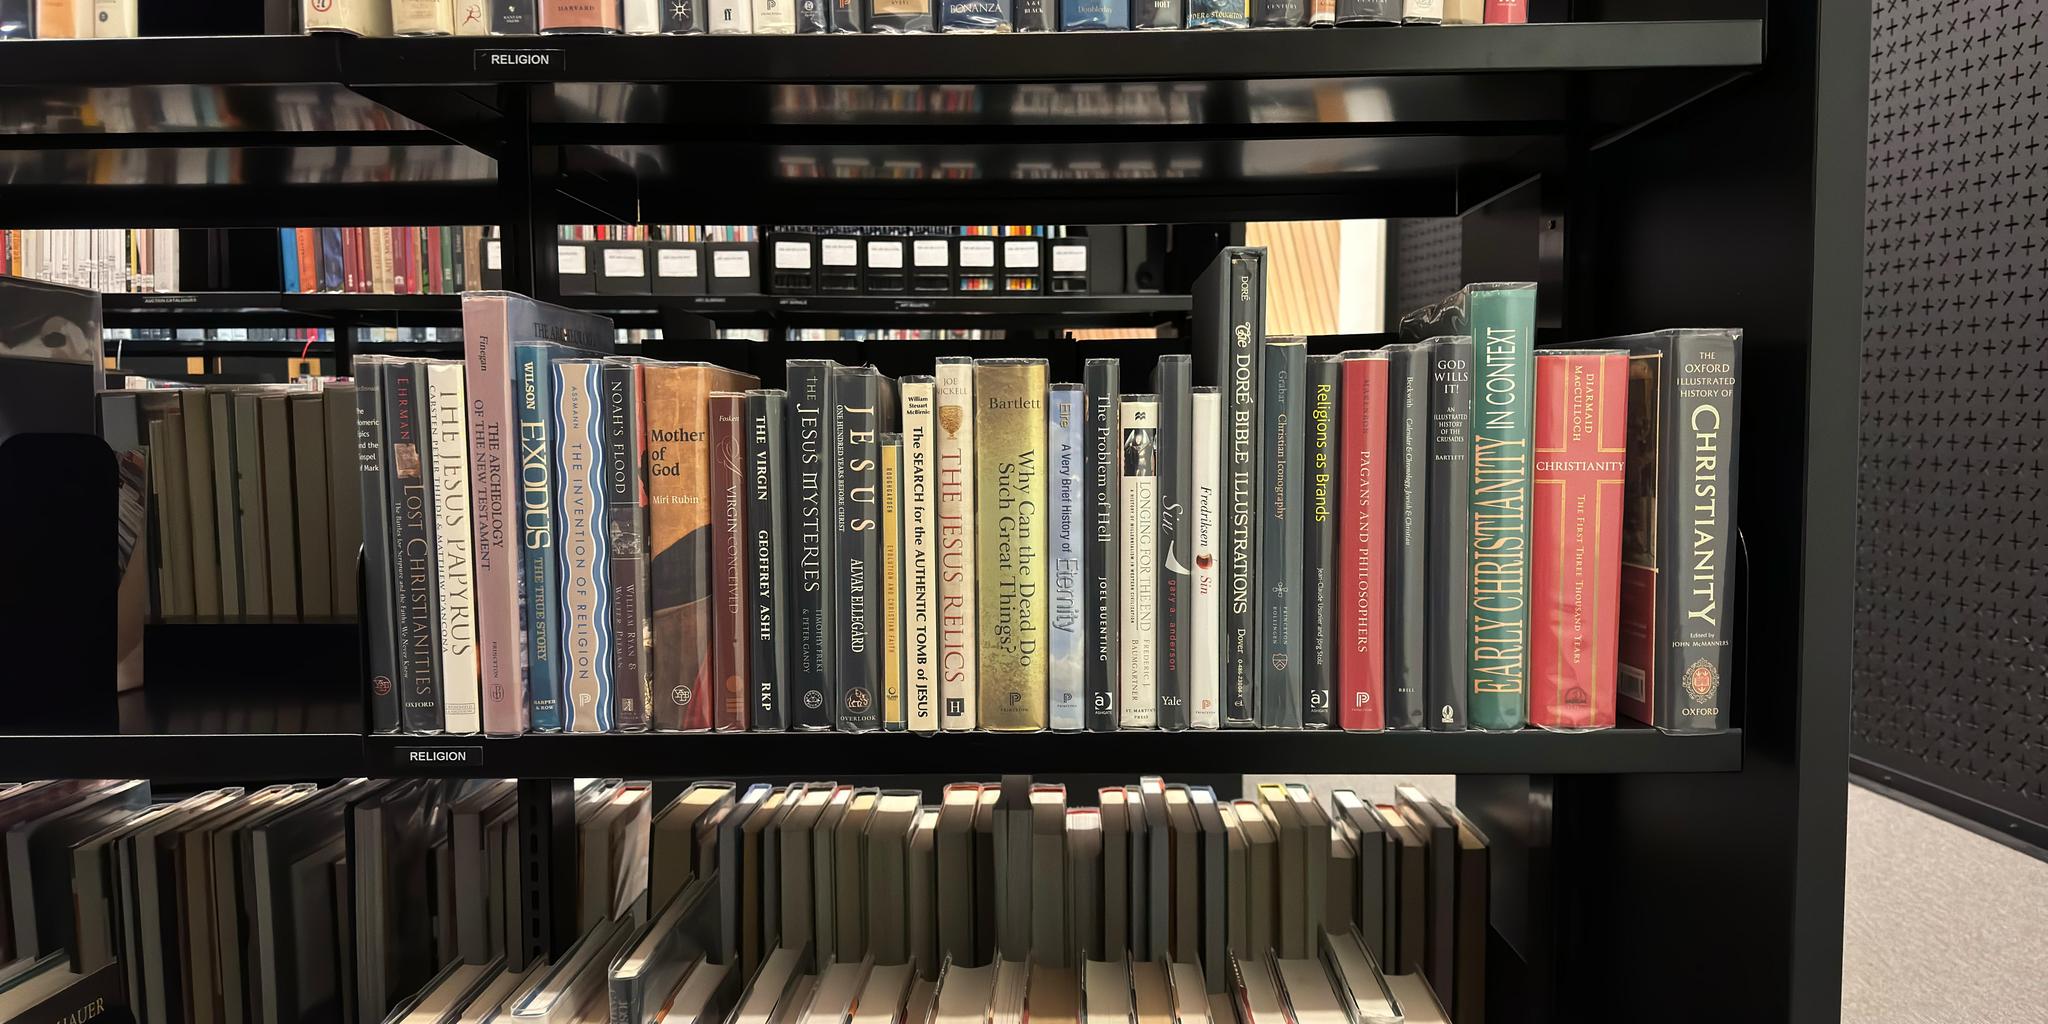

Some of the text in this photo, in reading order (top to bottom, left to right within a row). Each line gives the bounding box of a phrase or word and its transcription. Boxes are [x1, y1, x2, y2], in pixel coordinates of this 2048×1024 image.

[950, 5, 1002, 14] BONANZA
[491, 54, 549, 65] RELIGION
[1240, 275, 1251, 302] DORÉ
[479, 335, 490, 372] Finegan
[1437, 360, 1466, 370] GOD
[1685, 364, 1730, 373] OXFORD
[1699, 351, 1716, 360] THE
[524, 361, 536, 410] WILSON
[1278, 370, 1288, 404] Grabar
[1406, 376, 1414, 408] Beckwith
[1434, 372, 1469, 382] WILLS
[1444, 384, 1460, 394] IT!
[1676, 377, 1736, 386] ILLUSTRATED
[1680, 389, 1719, 398] HISTORY
[396, 378, 410, 440] EHRMAN
[571, 386, 579, 430] ASSMANN
[989, 397, 1041, 409] Bartlett
[1572, 365, 1584, 441] MacCULLOCH
[1584, 373, 1595, 434] DIARMAID
[611, 381, 626, 494] NOAH'S FLOOD
[651, 427, 705, 442] Mother
[652, 446, 667, 461] of
[796, 403, 820, 464] JESUS
[1312, 384, 1331, 522] Religions as Brands
[652, 462, 681, 476] God
[755, 416, 768, 501] THE VIRGIN
[844, 404, 876, 533] JESUS
[1060, 454, 1072, 476] Very
[1097, 393, 1111, 543] The Problem of Hell
[1232, 321, 1254, 614] The DORÉ BIBLE ILLUSTRATIONS
[1274, 413, 1288, 520] Christian Iconography
[1403, 453, 1413, 489] Chronology,
[1536, 461, 1624, 472] CHRISTIANITY
[473, 400, 491, 571] OF THE NEW TESTAMENT
[488, 422, 504, 548] THE ARCHEOLOGY
[520, 418, 551, 550] EXODUS
[652, 495, 700, 504] Miri Rubin
[1062, 479, 1072, 503] Brief
[1404, 489, 1413, 510] Jewish
[801, 472, 821, 593] MYSTERIES
[1060, 505, 1073, 540] History
[1162, 494, 1184, 535] Sin
[1199, 486, 1213, 547] Fredriksen
[1473, 326, 1526, 695] EARLY CHRISTIANITY IN CONTEXT
[1688, 403, 1720, 626] CHRISTIANITY
[572, 443, 589, 679] THE INVENTION OF RELIGION
[939, 447, 965, 683] THE JESUS RELICS
[994, 462, 1017, 654] Such Great Things?
[1012, 449, 1036, 667] Why Can the Dead Do
[1062, 543, 1073, 553] of
[1139, 481, 1152, 632] LONGING FOR THE END
[1357, 450, 1371, 653] PAGANS AND PHILOSOPHERS
[404, 484, 432, 695] LOST CHRISTIANITIES
[758, 529, 771, 641] GEOFFREY ASHE
[913, 426, 929, 718] The SEARCH for the AUTHENTIC TOMB of JESUS
[1199, 575, 1212, 595] Sin
[1573, 494, 1586, 664] THE FIRST THREE THOUSAND YEARS
[533, 557, 547, 662] THE TRUE STORY
[850, 558, 868, 653] ALVAR ELLEGÅRD
[1053, 558, 1080, 633] Eternity
[401, 626, 408, 636] We
[1098, 577, 1108, 662] JOEL BUENTING
[1236, 628, 1246, 654] Dover
[762, 682, 772, 711] RKP
[1161, 696, 1182, 706] Yale
[1681, 707, 1719, 716] OXFORD
[410, 751, 466, 761] RELIGION
